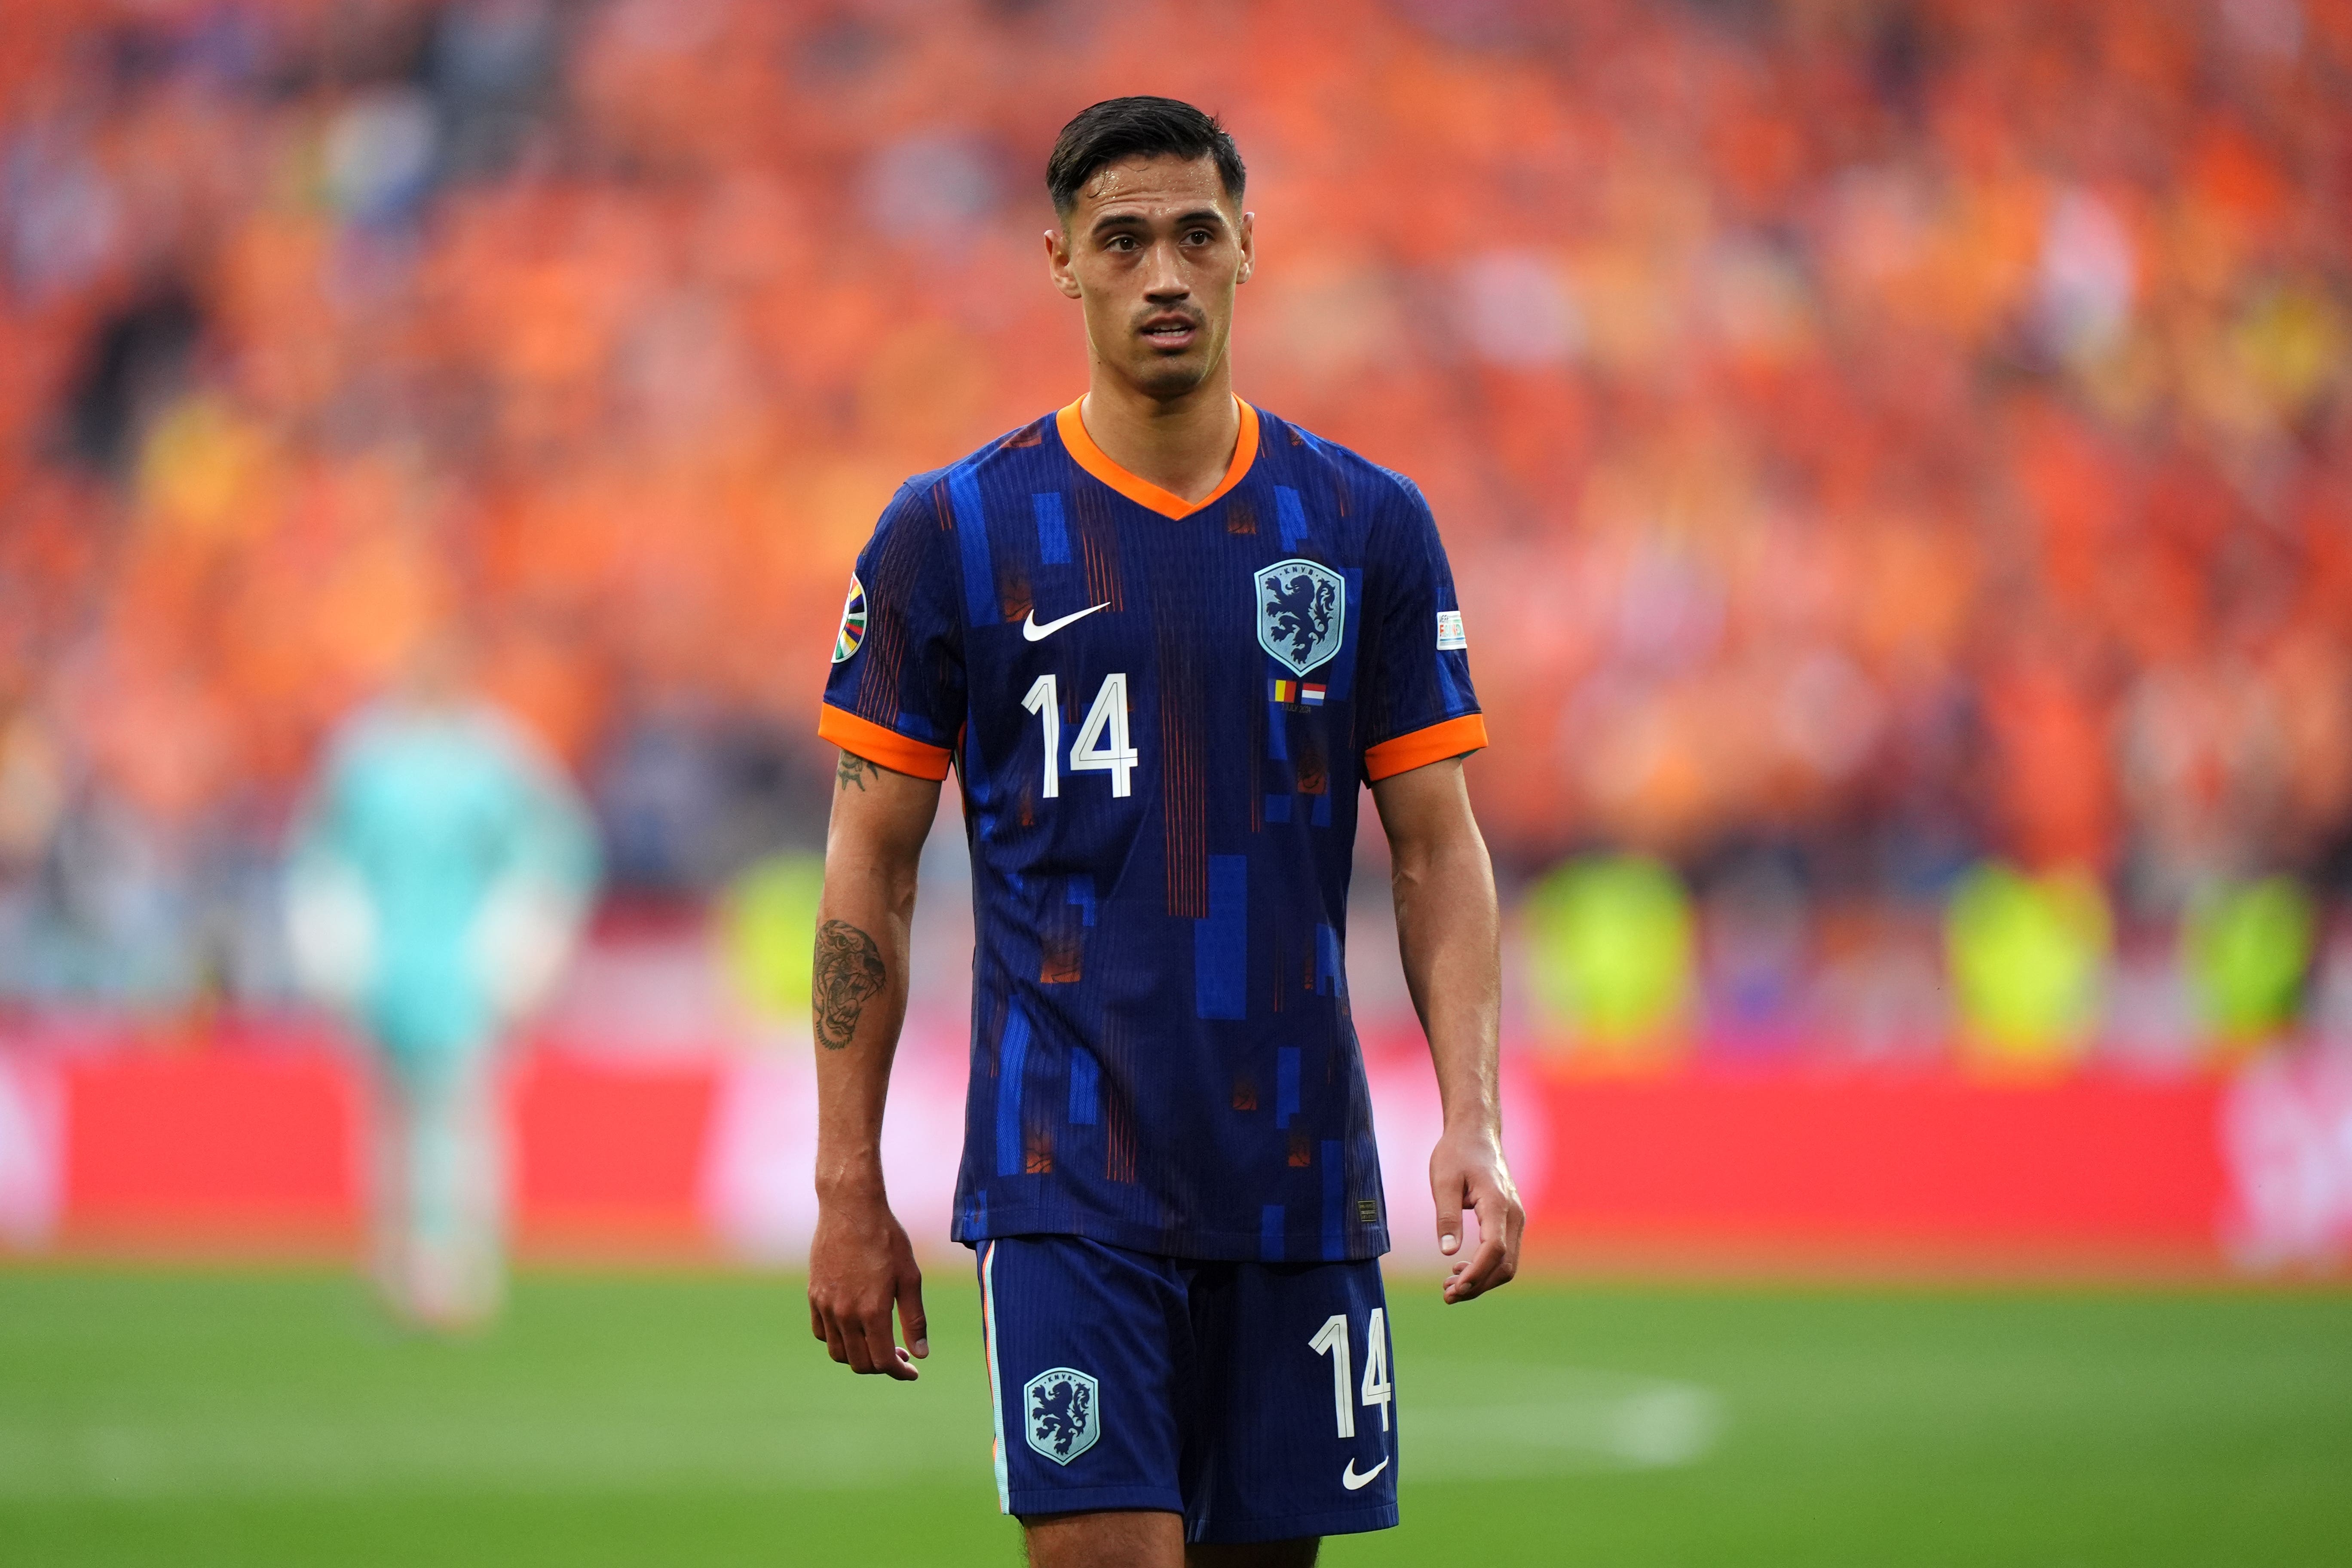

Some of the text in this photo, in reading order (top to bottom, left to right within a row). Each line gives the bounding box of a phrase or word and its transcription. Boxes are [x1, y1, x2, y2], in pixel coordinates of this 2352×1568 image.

[1284, 566, 1314, 575] KNVB
[1021, 673, 1138, 798] 14
[1048, 1374, 1072, 1382] KNVB
[1308, 1308, 1391, 1438] 14
